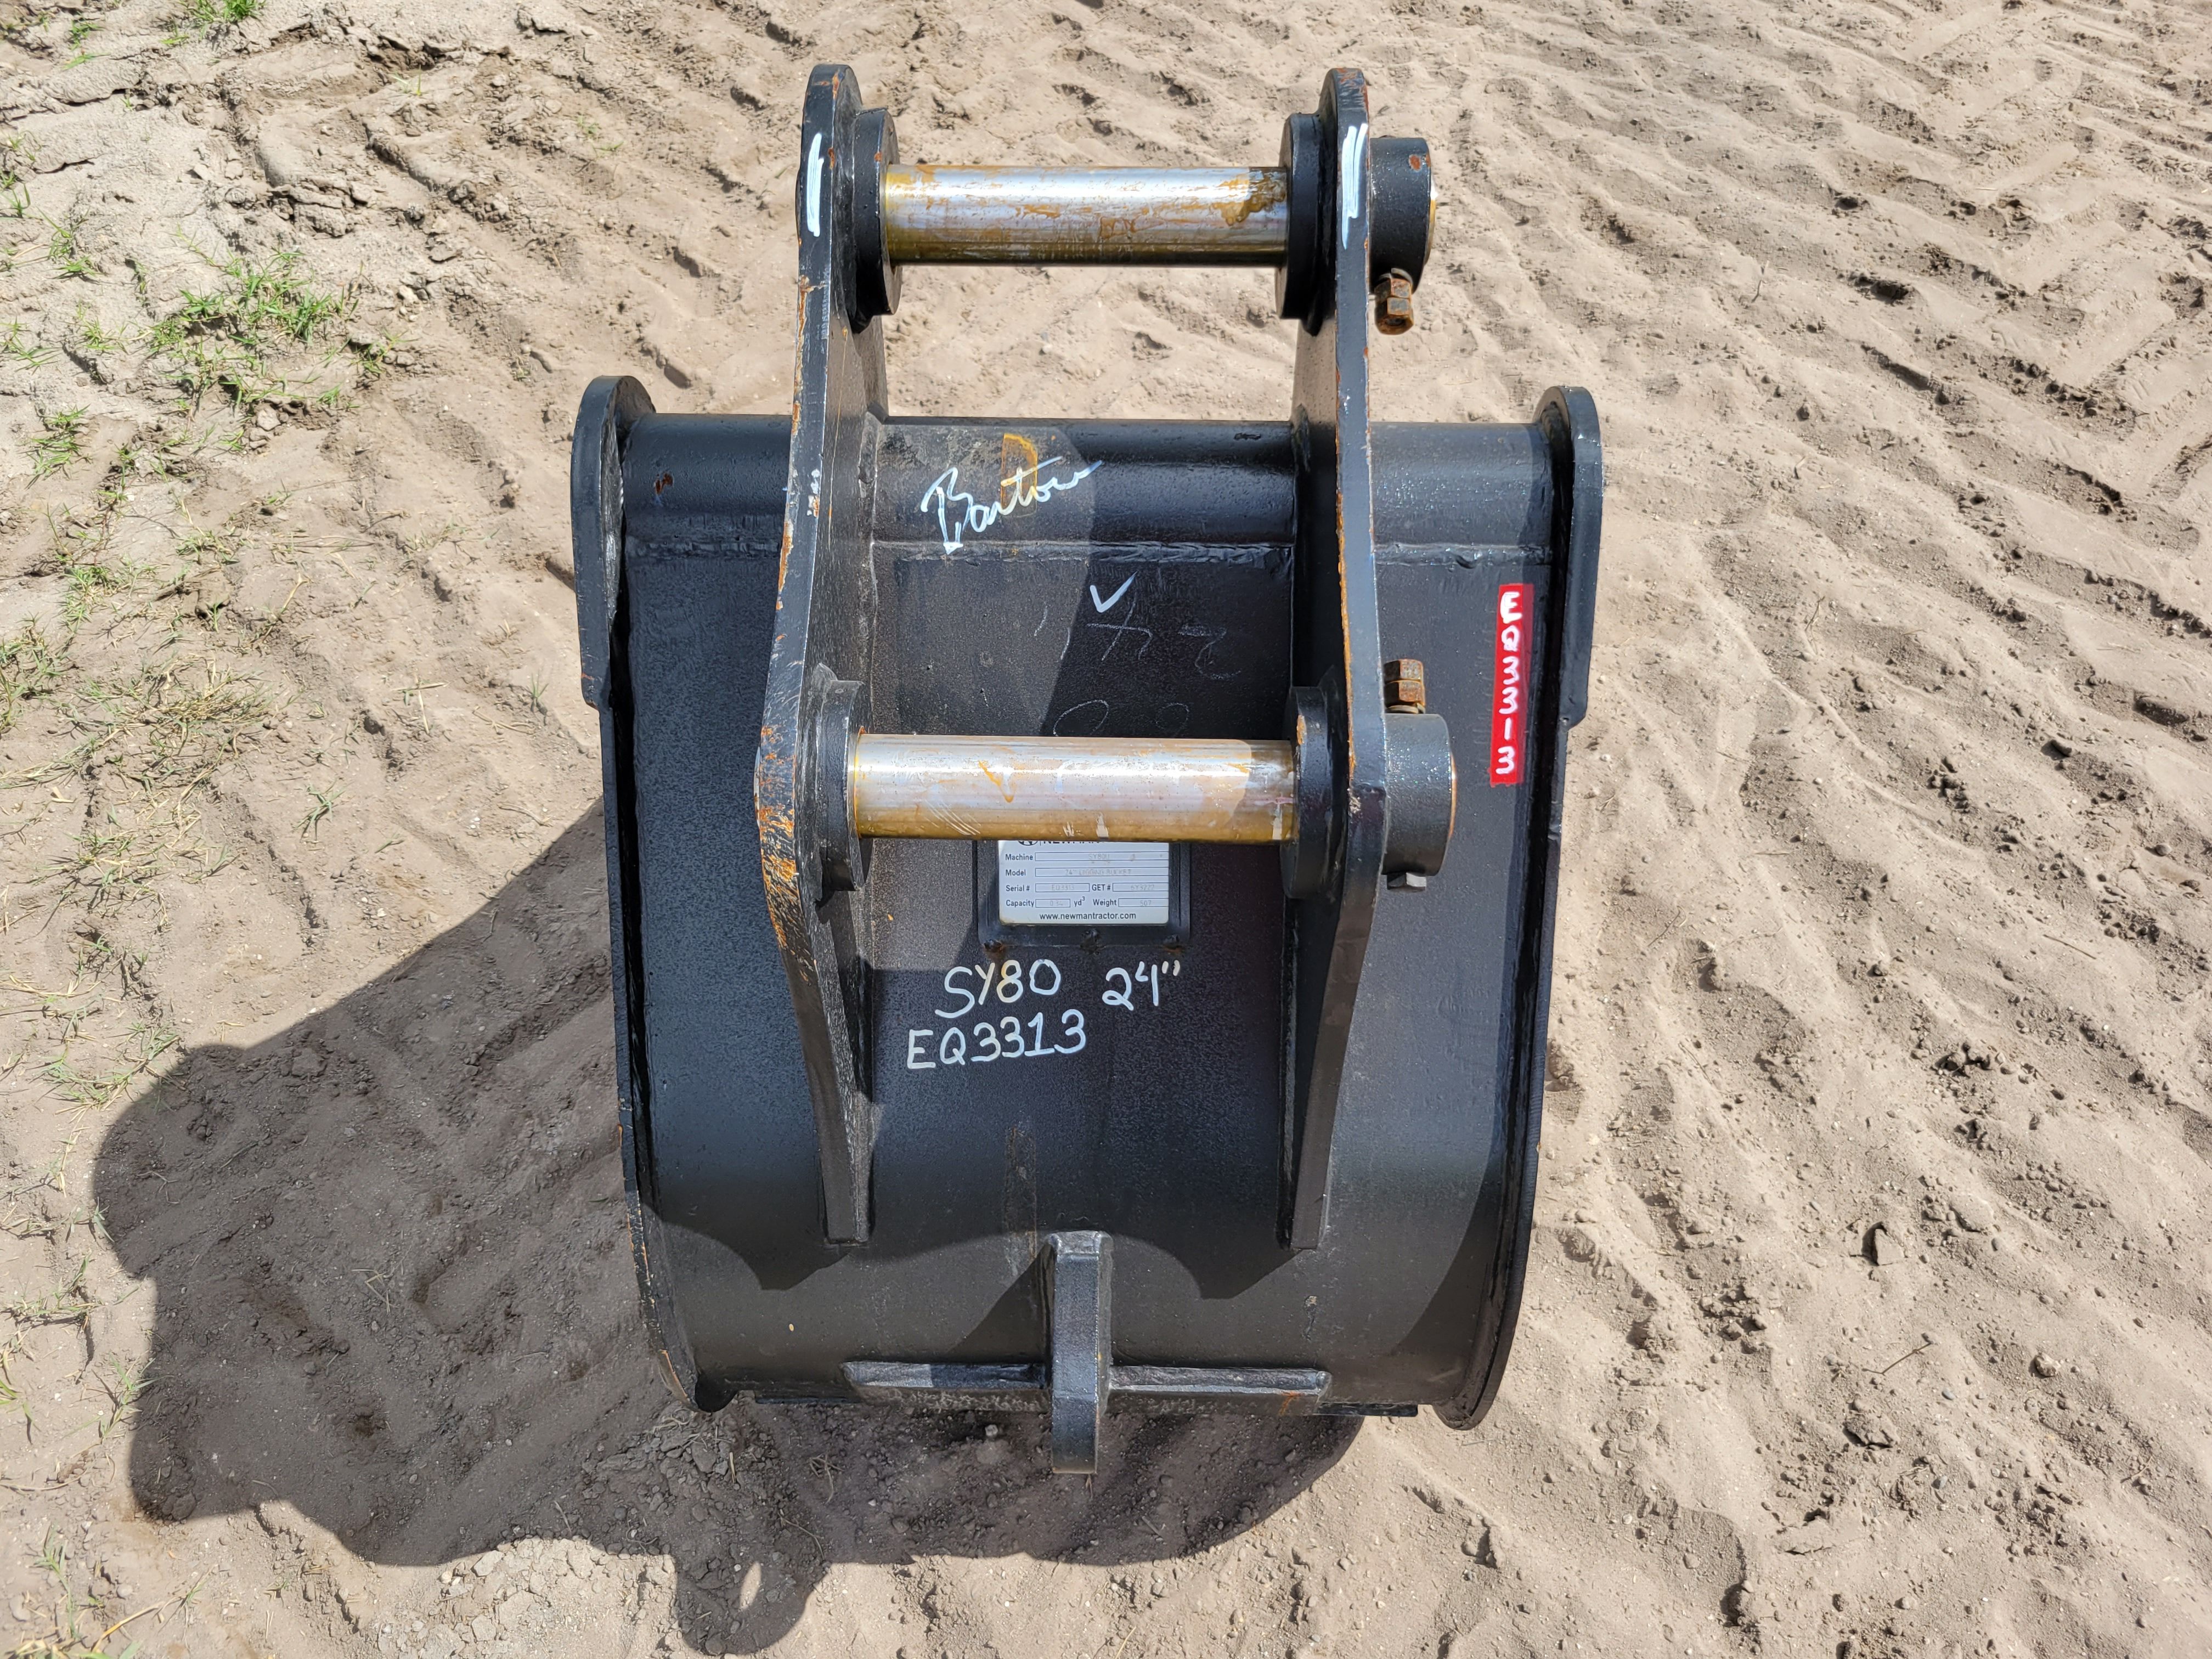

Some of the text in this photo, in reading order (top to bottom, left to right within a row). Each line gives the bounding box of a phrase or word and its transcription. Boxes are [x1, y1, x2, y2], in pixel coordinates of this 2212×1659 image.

[1496, 591, 1522, 774] EQ3313
[1006, 899, 1035, 908] Capacity
[1039, 911, 1137, 921] www.newmantractor.com
[1092, 899, 1117, 907] Weight
[935, 958, 1061, 1018] SY80
[907, 1008, 1086, 1069] EQ3313
